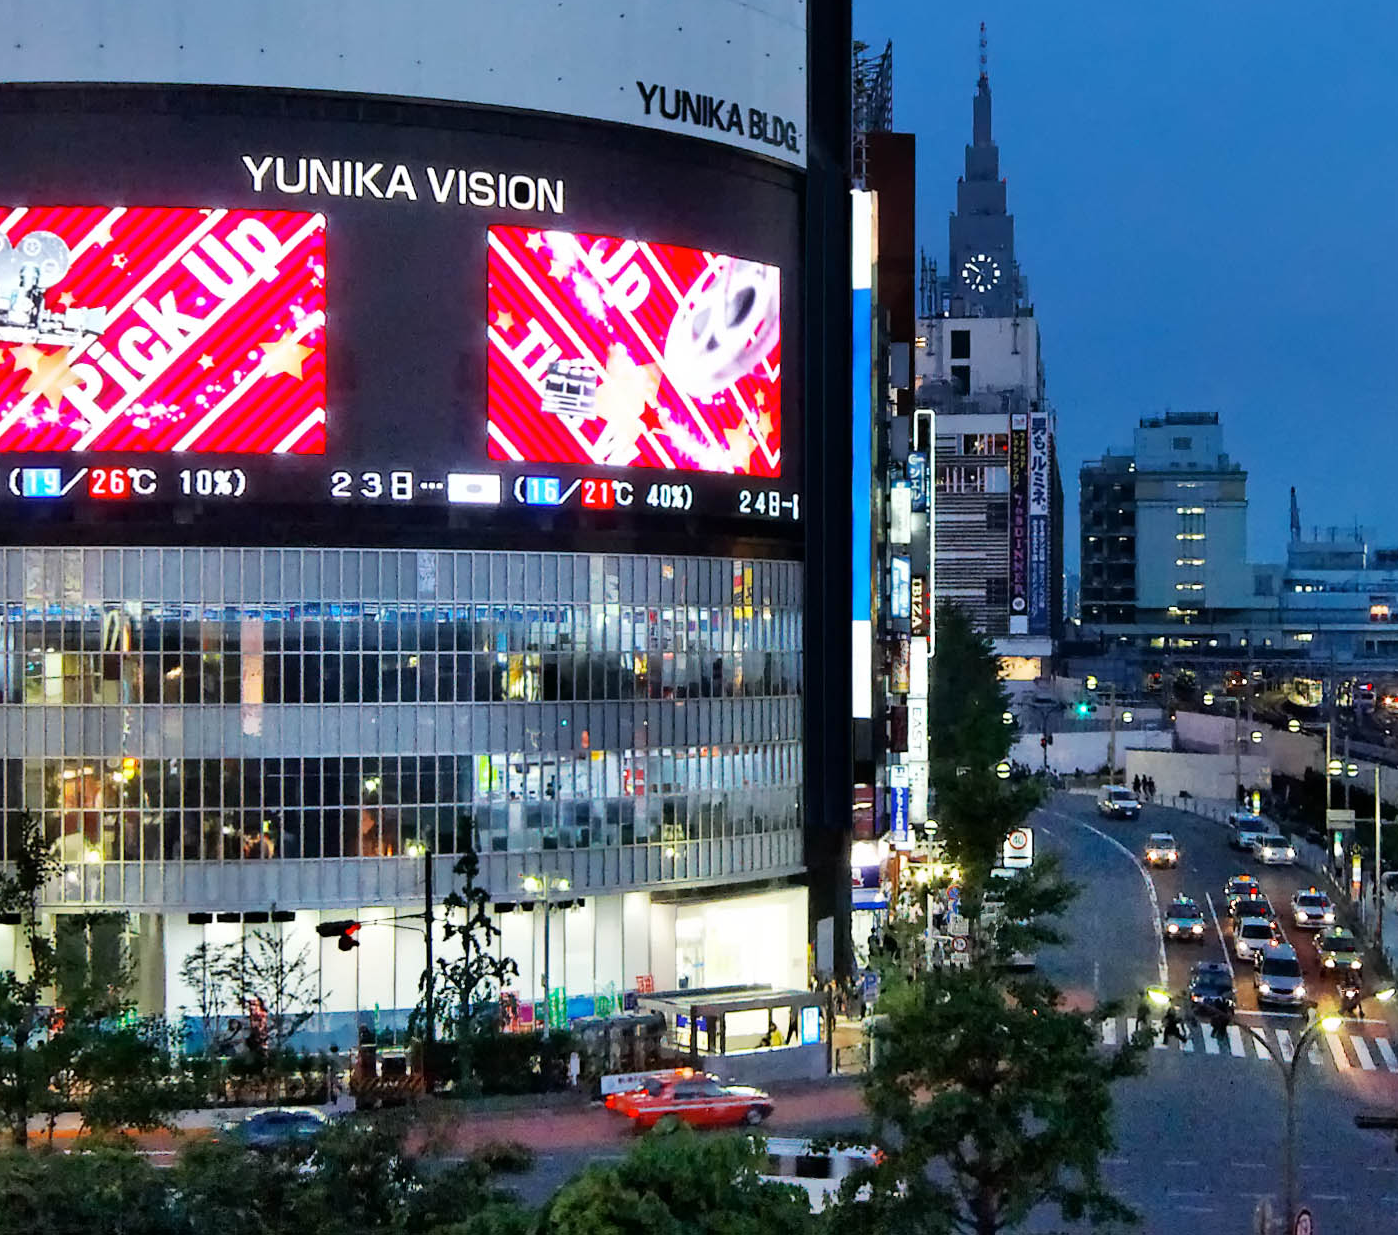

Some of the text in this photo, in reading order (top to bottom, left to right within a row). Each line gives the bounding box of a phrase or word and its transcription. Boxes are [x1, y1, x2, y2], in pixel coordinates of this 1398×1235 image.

[636, 81, 800, 154] YUNIKA BLDG.
[241, 155, 564, 214] YUNIKA VISION
[180, 468, 248, 498] 10%)
[646, 483, 693, 511] 40%)
[911, 577, 923, 629] IBIZA
[912, 706, 922, 753] EAST
[1013, 835, 1024, 845] 40
